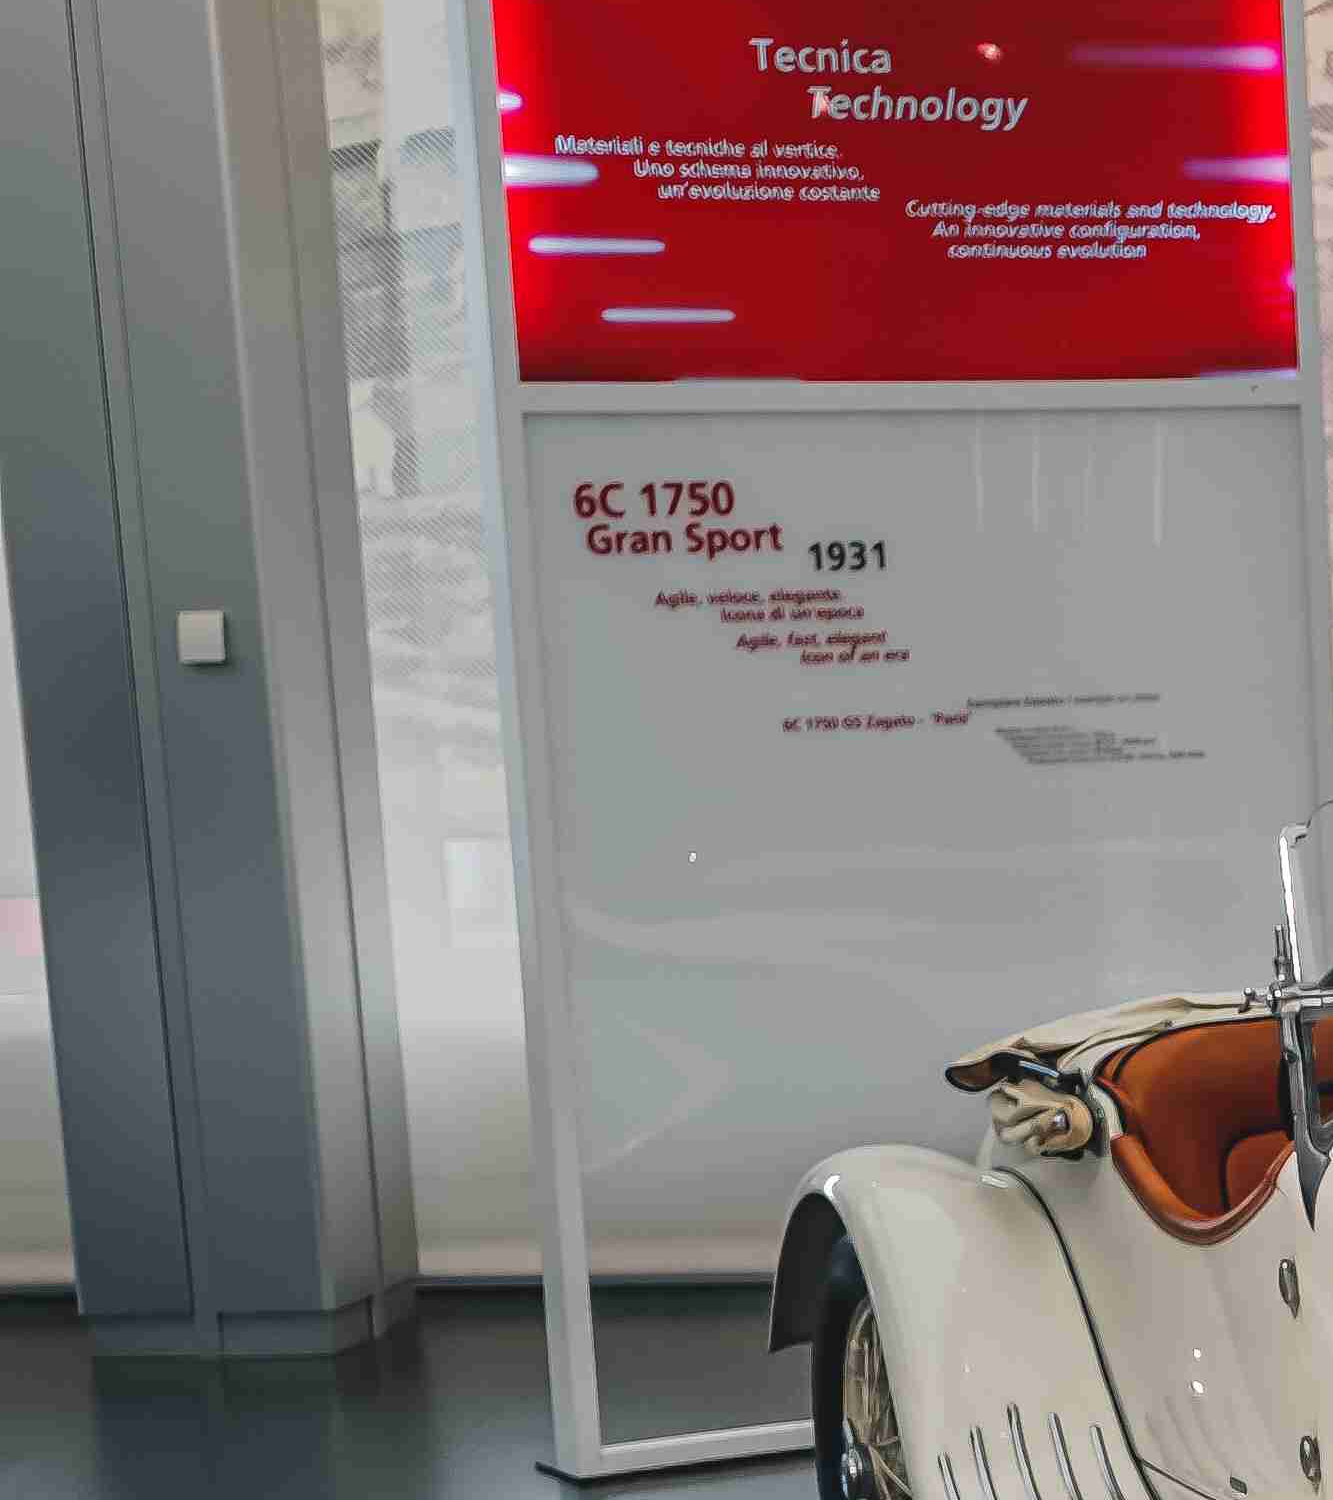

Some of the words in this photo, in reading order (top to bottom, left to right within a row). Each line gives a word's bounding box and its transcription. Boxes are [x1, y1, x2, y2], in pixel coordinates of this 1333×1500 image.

[749, 37, 892, 74] Tecnica
[807, 85, 1029, 131] Technology
[554, 134, 643, 156] Materiali
[648, 142, 661, 157] e
[665, 138, 746, 158] tecniche
[750, 139, 768, 158] al
[633, 159, 675, 177] Uno
[679, 159, 752, 179] schema
[755, 161, 866, 181] innovativo,
[657, 180, 796, 201] un'evoluzione
[799, 183, 882, 202] costante
[904, 200, 1030, 222] Cutting-edge
[1035, 200, 1121, 218] materials
[1125, 201, 1163, 219] and
[932, 221, 960, 238] An
[964, 220, 1064, 239] innovative
[1069, 220, 1201, 243] configuration,
[947, 241, 1052, 260] continuous
[1056, 241, 1148, 260] evolution
[573, 482, 626, 518] 6C
[639, 481, 736, 518] 1750
[586, 523, 673, 556] Gran
[684, 521, 785, 562] Sport
[807, 539, 888, 572] 1931
